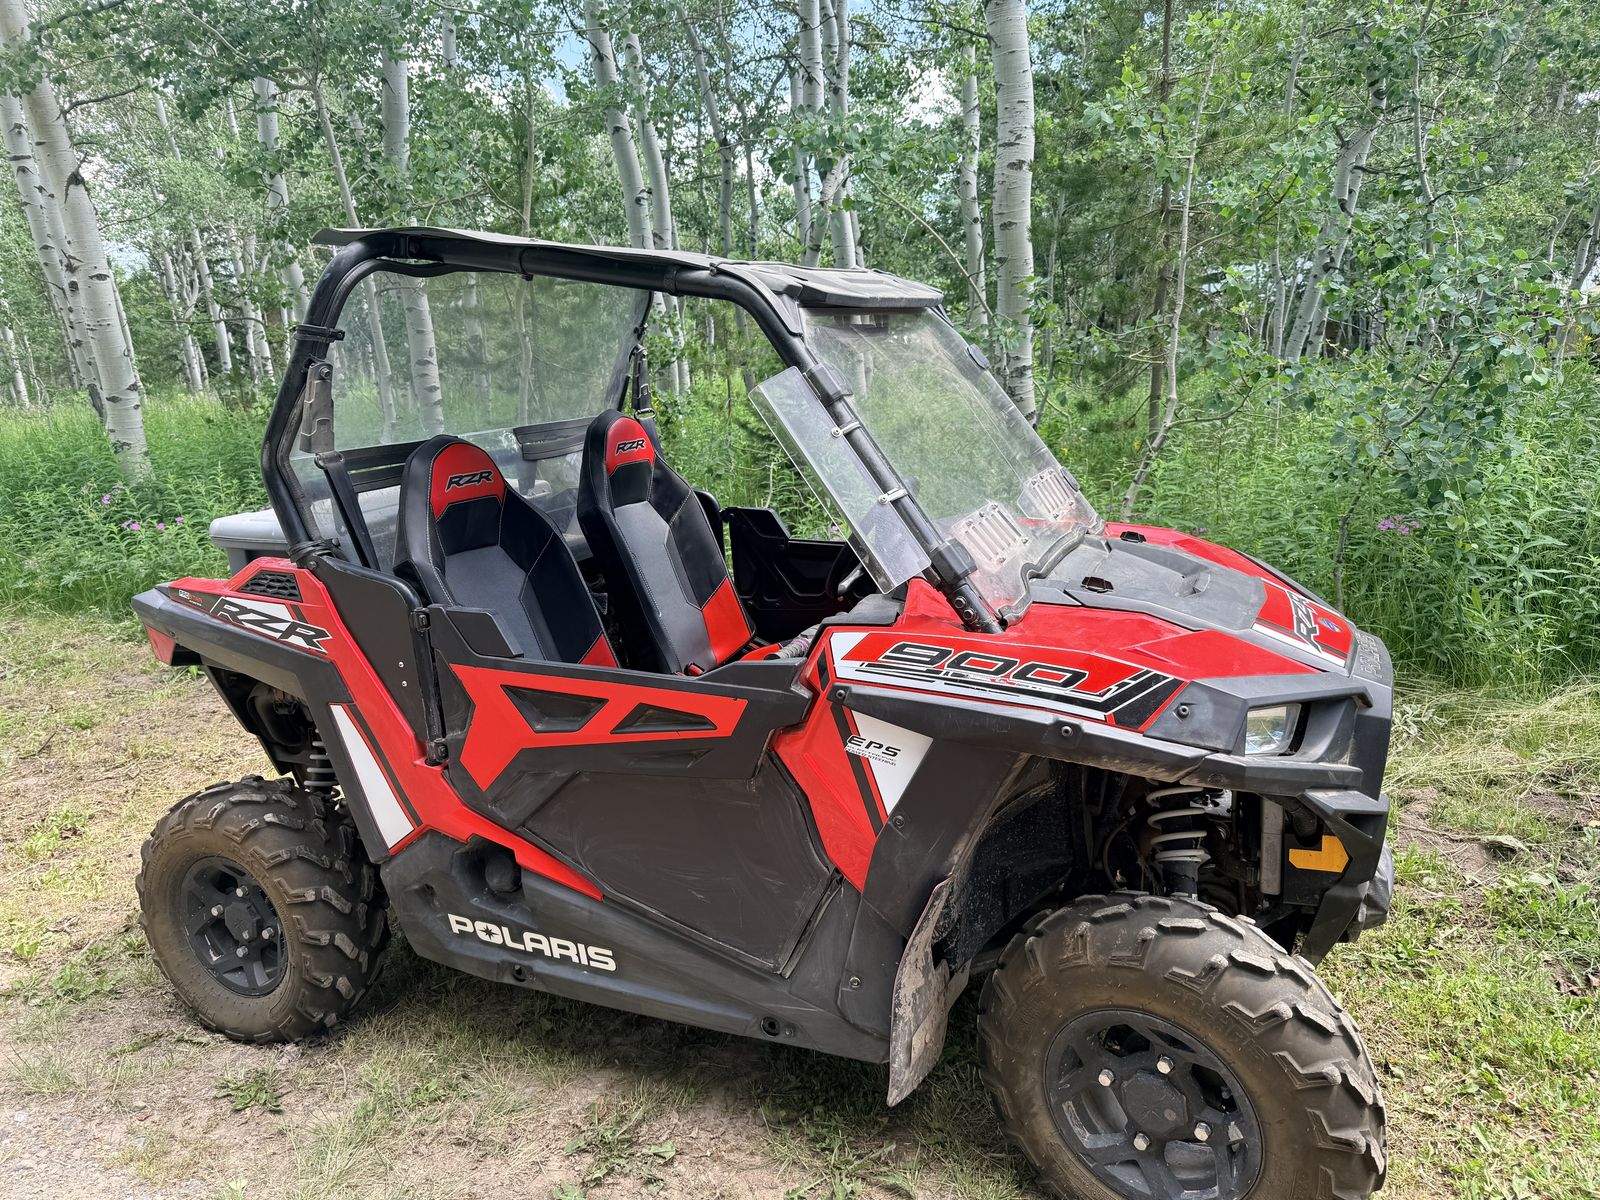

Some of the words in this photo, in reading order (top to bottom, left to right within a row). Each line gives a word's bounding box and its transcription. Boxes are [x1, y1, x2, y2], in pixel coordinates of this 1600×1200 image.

[614, 438, 646, 455] RZR
[445, 470, 495, 492] RZR
[212, 598, 332, 653] RZR
[1285, 588, 1322, 655] RZR
[877, 640, 1089, 689] 900
[847, 735, 901, 757] EPS
[447, 913, 617, 972] POLARIS
